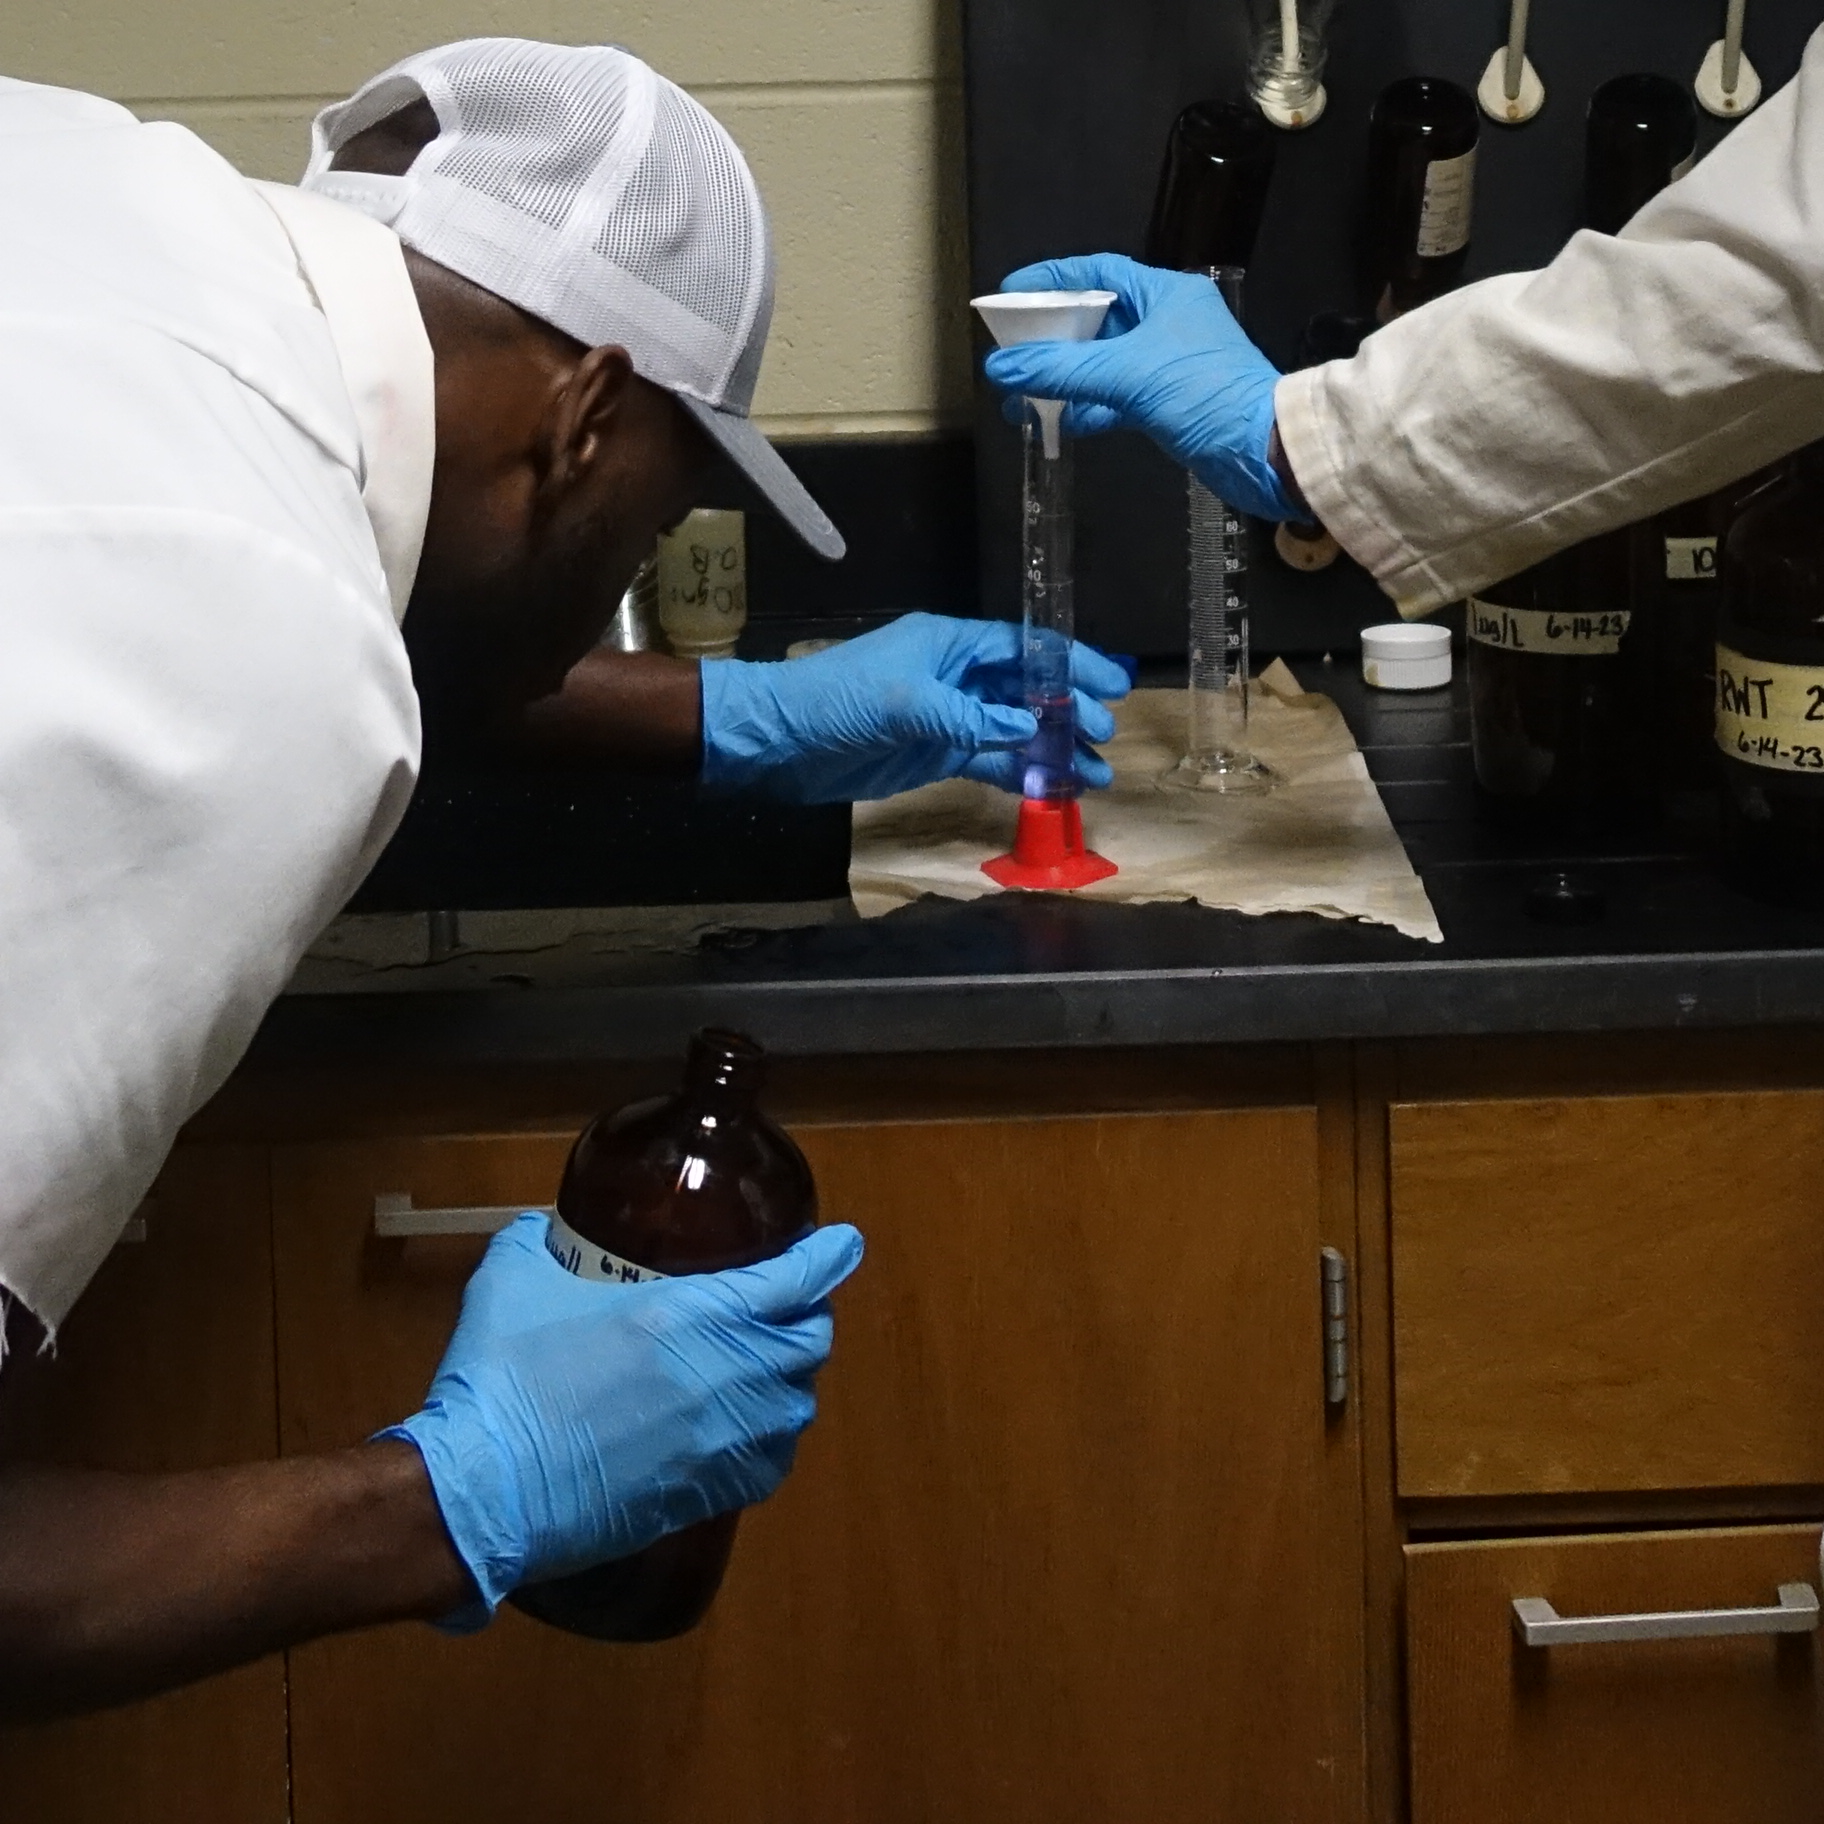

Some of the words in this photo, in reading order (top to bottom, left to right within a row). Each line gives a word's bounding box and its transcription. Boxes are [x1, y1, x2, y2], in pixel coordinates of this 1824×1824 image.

[1546, 613, 1624, 640] 6-14-23
[1719, 669, 1774, 719] RWT
[1736, 729, 1824, 768] 6-14-23
